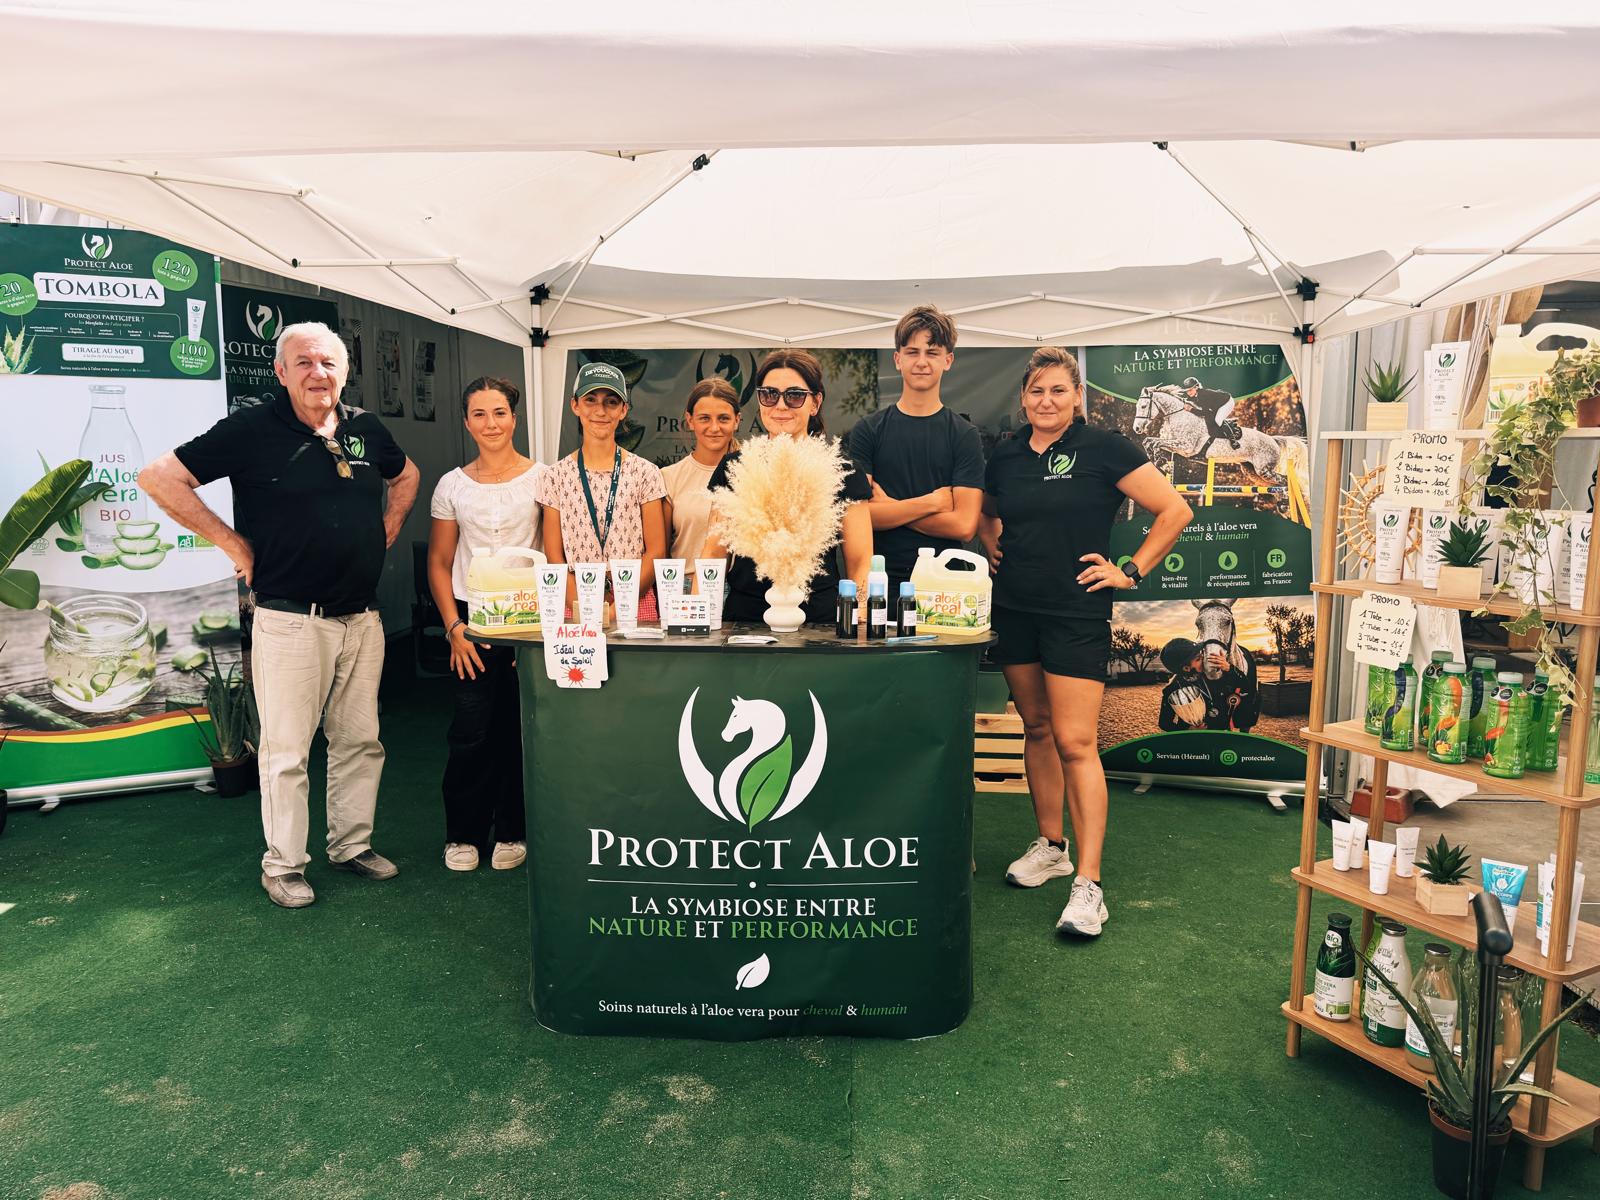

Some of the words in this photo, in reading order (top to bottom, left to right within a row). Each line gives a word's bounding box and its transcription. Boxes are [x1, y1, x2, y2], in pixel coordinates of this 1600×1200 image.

[64, 257, 107, 269] PROTECT
[108, 261, 134, 271] ALOE
[162, 257, 191, 276] 120
[39, 277, 160, 300] TOMBOLA
[64, 312, 101, 321] POURQUOI
[180, 342, 207, 357] 100
[1134, 351, 1150, 361] LA
[1152, 345, 1214, 359] SYMBIOSE
[1216, 344, 1258, 356] ENTRE
[1113, 360, 1164, 374] NATURE
[1166, 358, 1183, 370] ET
[1185, 354, 1278, 369] PERFORMANCE
[249, 376, 260, 385] ET
[1412, 432, 1448, 445] PROMO
[98, 453, 126, 464] JUS
[1393, 474, 1401, 484] 3
[1394, 485, 1400, 495] 4
[99, 509, 131, 522] BIO
[1206, 523, 1213, 532] à
[1213, 522, 1239, 532] l'aloe
[1205, 532, 1214, 541] &
[1215, 531, 1250, 541] humain
[1270, 554, 1283, 563] FR
[1209, 572, 1247, 581] performance
[1262, 570, 1293, 578] fabrication
[1213, 579, 1250, 589] récupération
[1370, 593, 1400, 606] PROMO
[935, 601, 962, 615] real
[556, 625, 580, 639] Aloé
[1358, 632, 1363, 641] 3
[579, 644, 596, 657] Coup
[1357, 642, 1363, 650] 4
[560, 656, 570, 665] de
[1156, 752, 1180, 760] Servian
[1180, 752, 1210, 761] (Hérault)
[1241, 754, 1276, 763] protectaloe
[587, 828, 791, 870] PROTECT
[802, 831, 919, 870] ALOE
[630, 896, 660, 916] LA
[667, 897, 788, 917] SYMBIOSE
[795, 897, 876, 917] ENTRE
[588, 917, 687, 938] NATURE
[694, 921, 724, 939] ET
[731, 918, 918, 939] PERFORMANCE
[598, 1000, 633, 1013] Soins
[636, 1003, 687, 1015] naturels
[690, 1003, 698, 1016] à
[737, 1008, 765, 1017] vera
[767, 1008, 800, 1021] pour
[803, 1004, 843, 1016] cheval
[846, 1004, 858, 1016] &
[860, 1003, 908, 1016] humain
